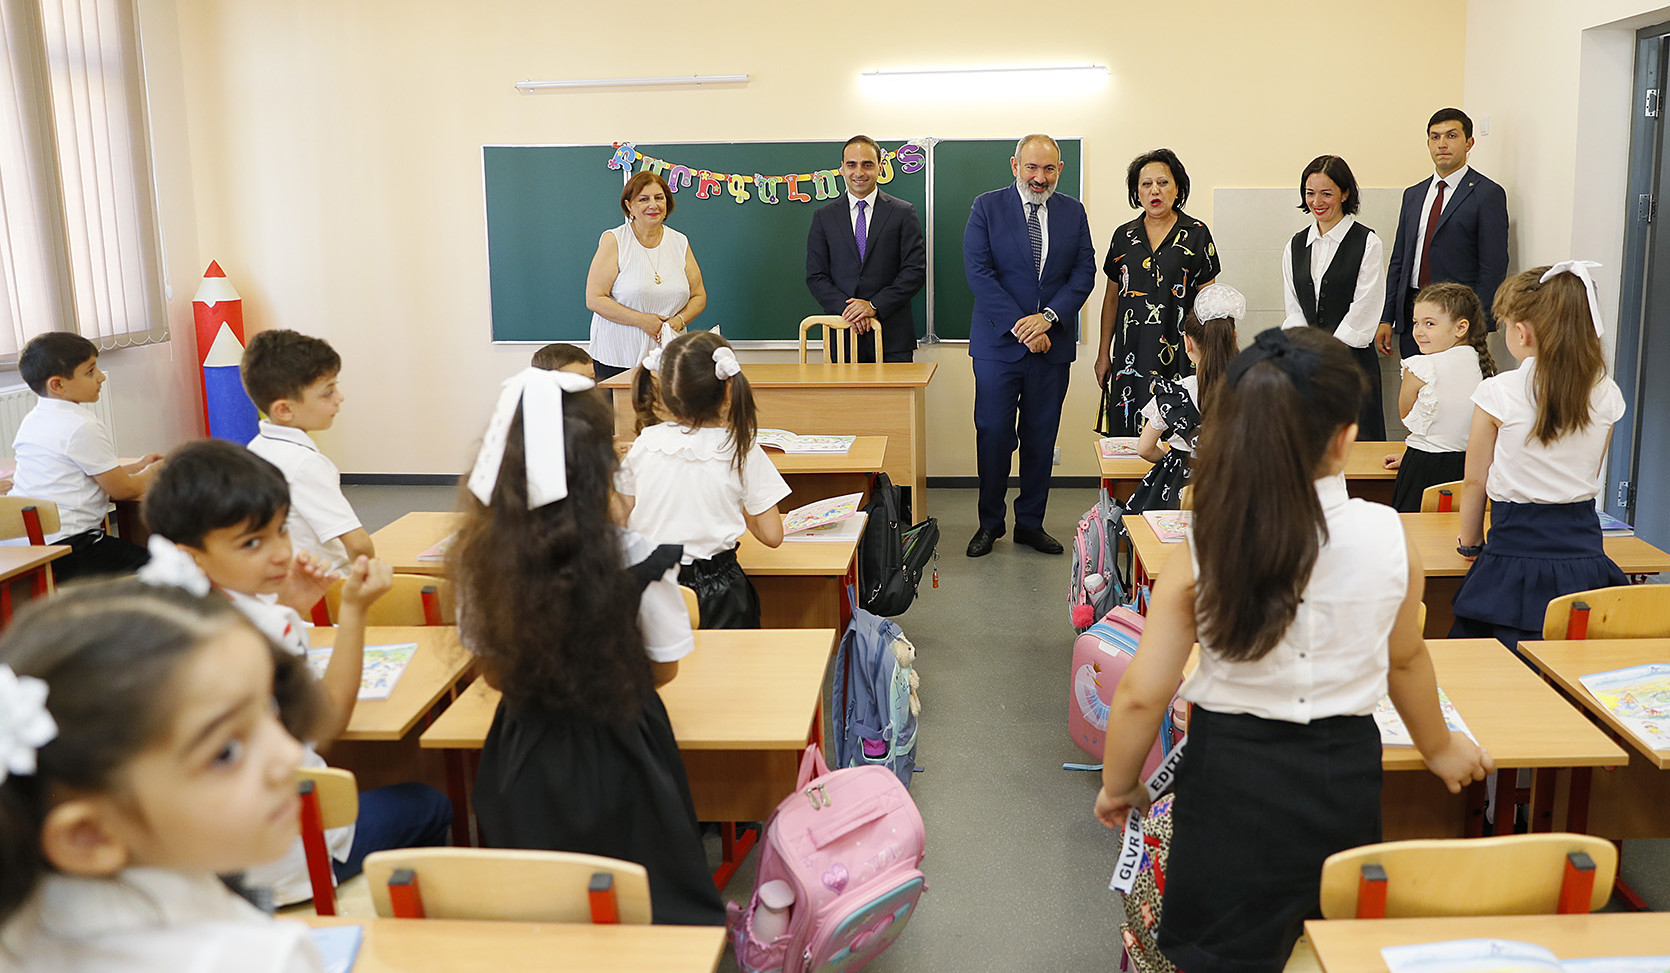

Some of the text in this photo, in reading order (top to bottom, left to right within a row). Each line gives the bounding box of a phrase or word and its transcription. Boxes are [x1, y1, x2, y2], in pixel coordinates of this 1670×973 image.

[727, 144, 926, 205] ԳԱԼՈՍՏ
[1119, 807, 1142, 880] GLVR BE
